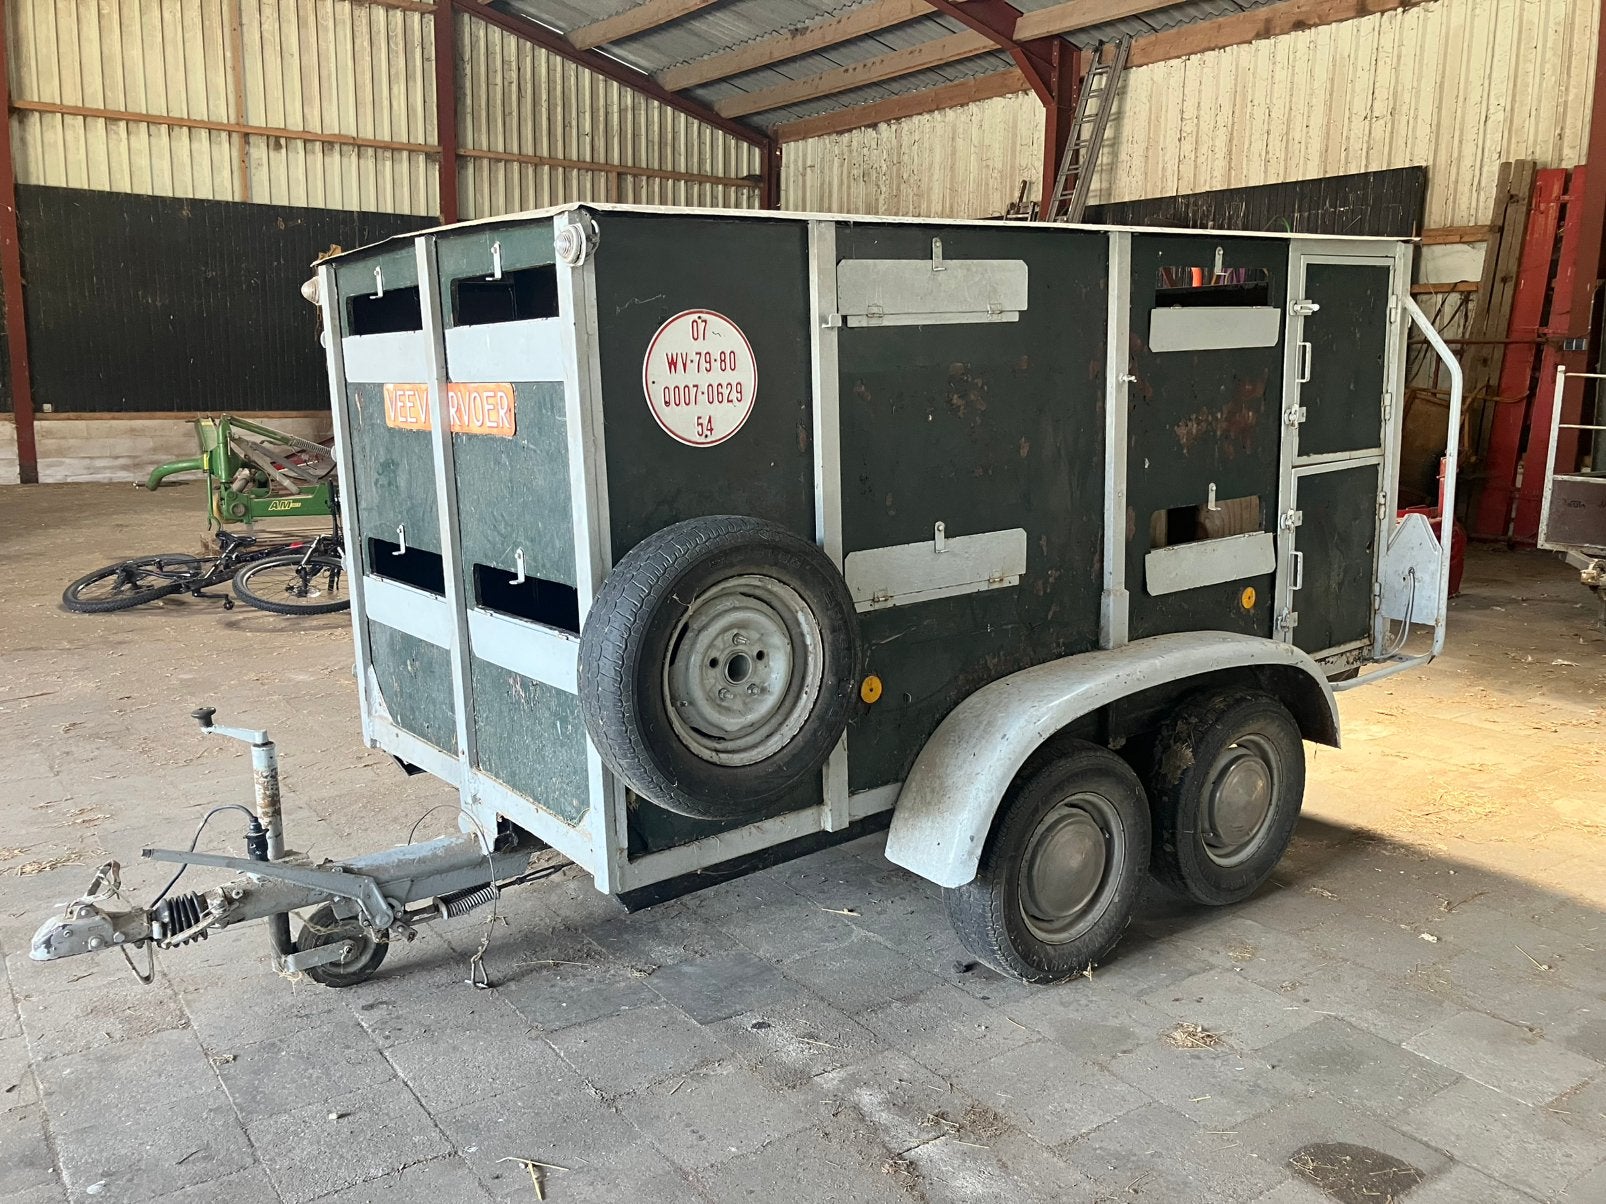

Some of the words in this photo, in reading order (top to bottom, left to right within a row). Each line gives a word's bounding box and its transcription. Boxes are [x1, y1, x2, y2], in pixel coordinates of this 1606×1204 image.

[691, 318, 708, 341] 07
[384, 390, 511, 428] VEEVRVOER
[697, 415, 714, 437] 54
